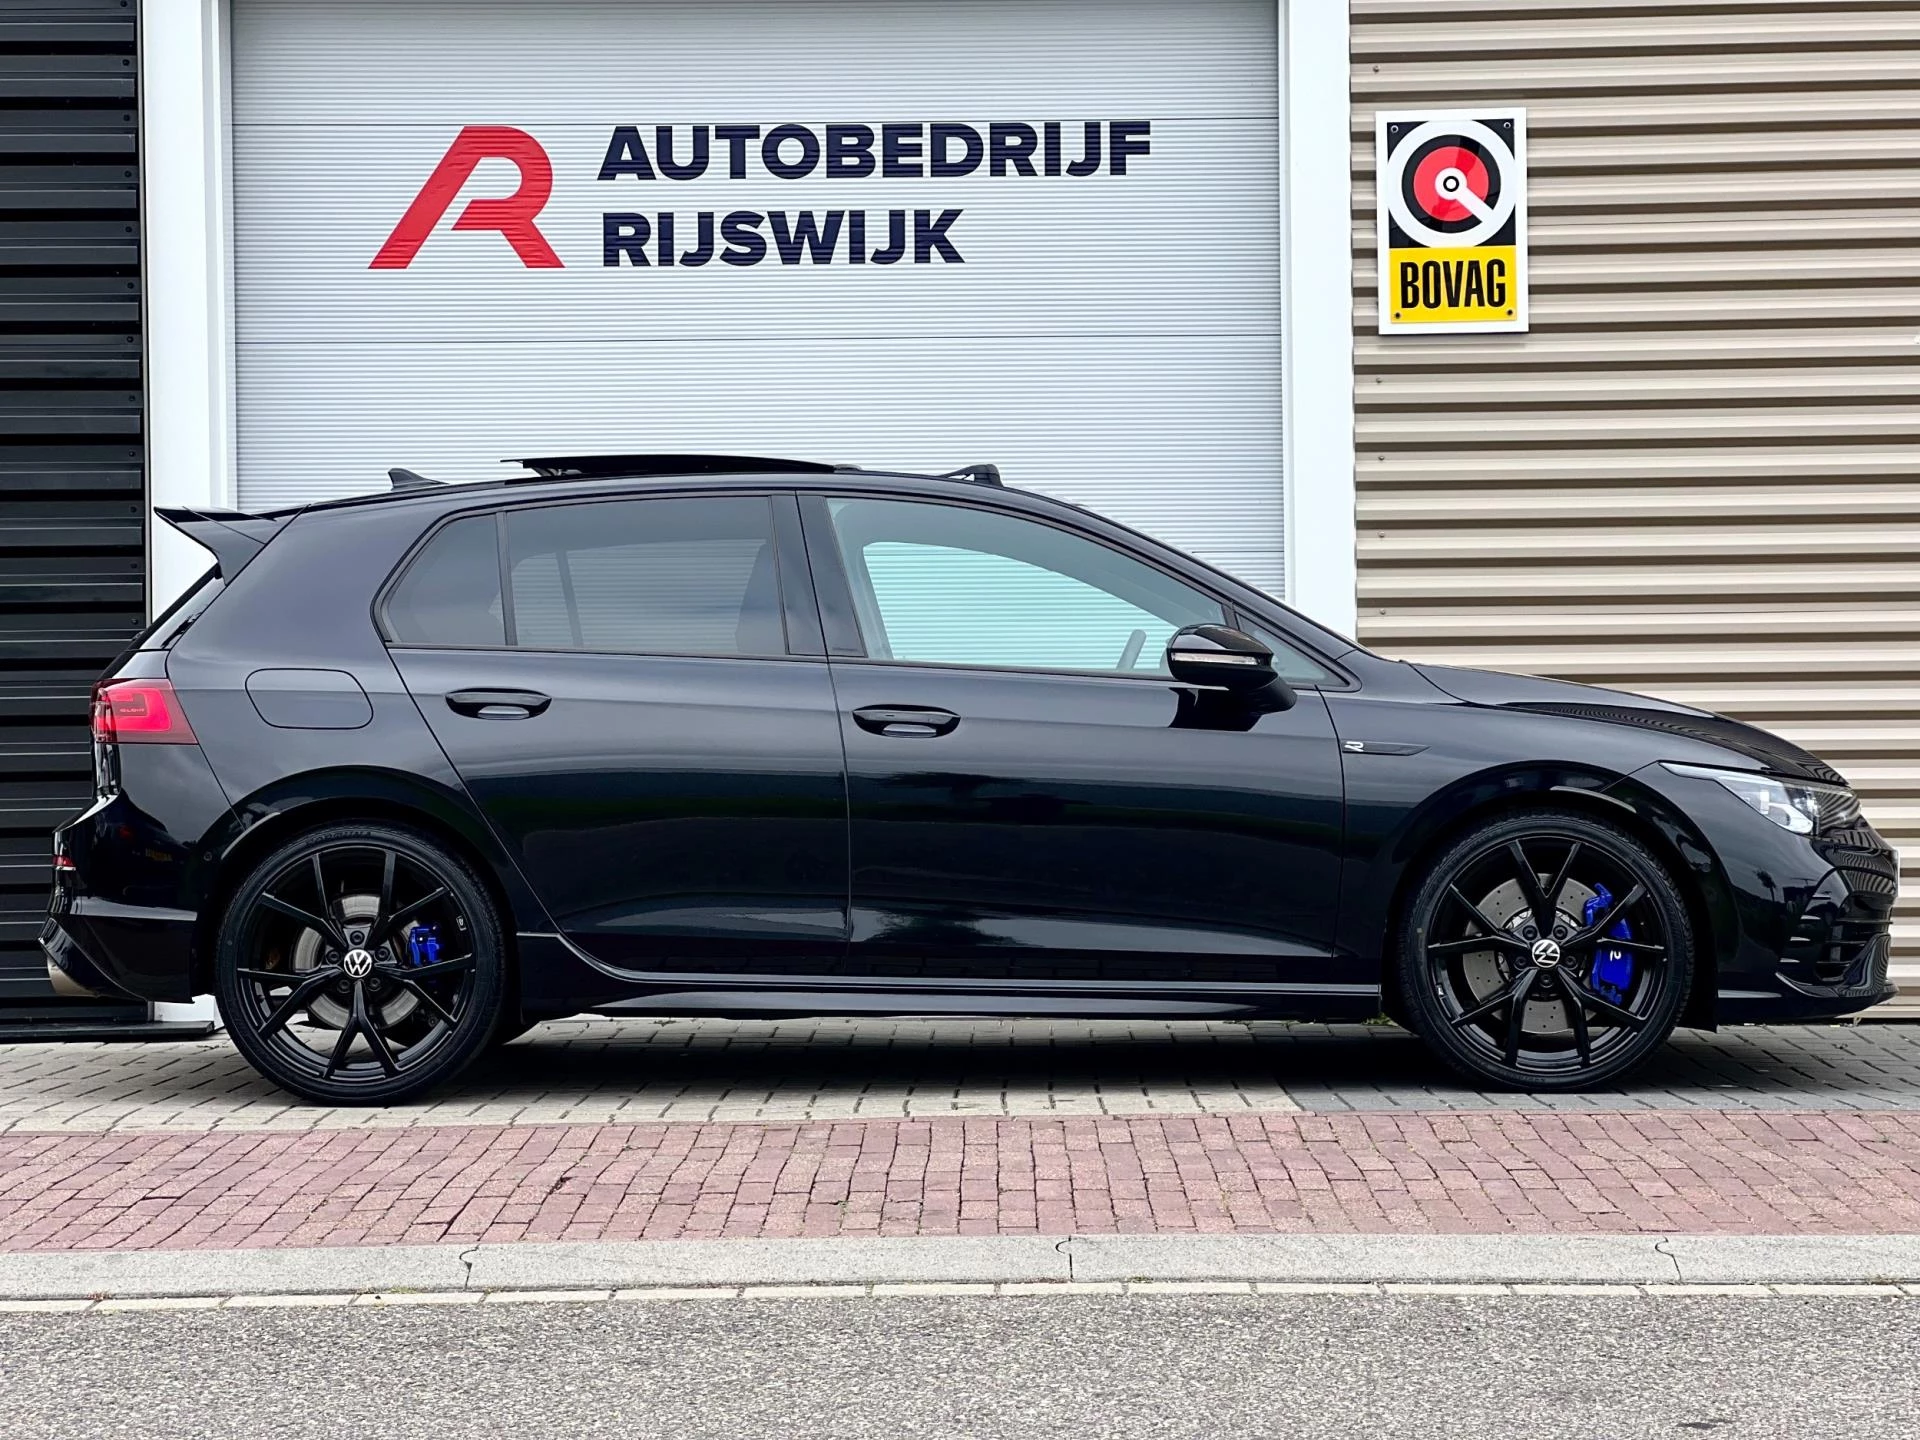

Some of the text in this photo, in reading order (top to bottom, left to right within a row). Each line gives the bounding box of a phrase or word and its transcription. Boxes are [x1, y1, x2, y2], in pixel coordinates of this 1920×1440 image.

[597, 120, 1151, 181] AUTOBEDRIJF
[602, 208, 966, 267] RIJSWIJK
[1400, 258, 1506, 309] BOVAG
